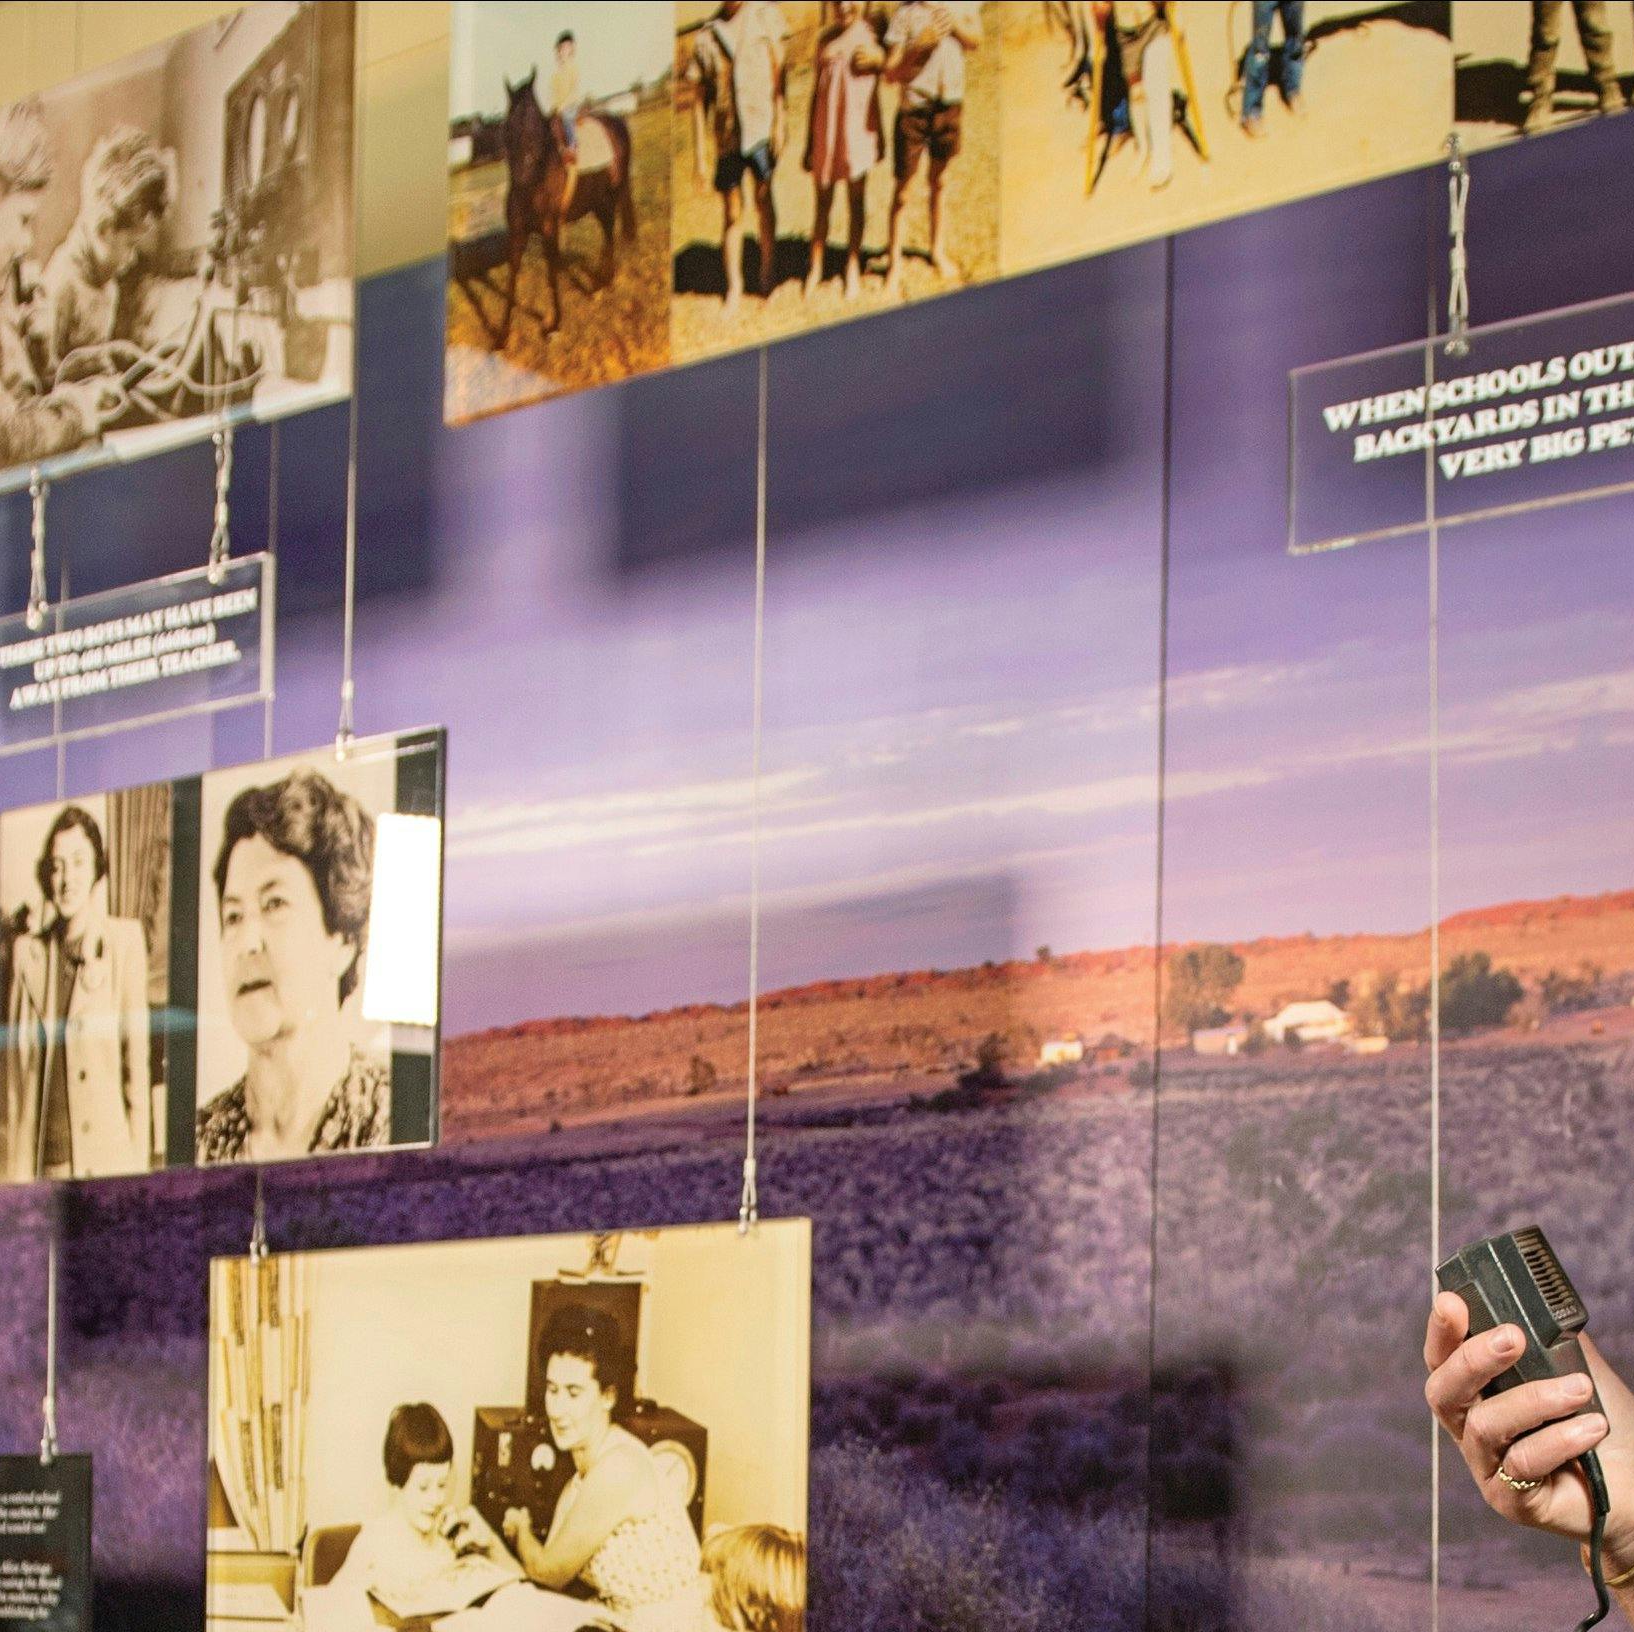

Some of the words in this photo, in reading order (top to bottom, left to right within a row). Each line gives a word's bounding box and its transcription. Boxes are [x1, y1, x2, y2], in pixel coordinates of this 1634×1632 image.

[1322, 385, 1426, 433] WHEN
[1425, 356, 1565, 411] SCHOOLS
[1353, 397, 1539, 463] BACKYARDS
[1542, 390, 1583, 425] IN
[1438, 436, 1529, 481] VERY
[1529, 425, 1586, 464] BIG
[46, 628, 84, 657] TWO
[125, 608, 164, 640] MAY
[165, 597, 213, 630] HAVE
[9, 678, 61, 710] AWAY
[61, 668, 110, 699] FROM
